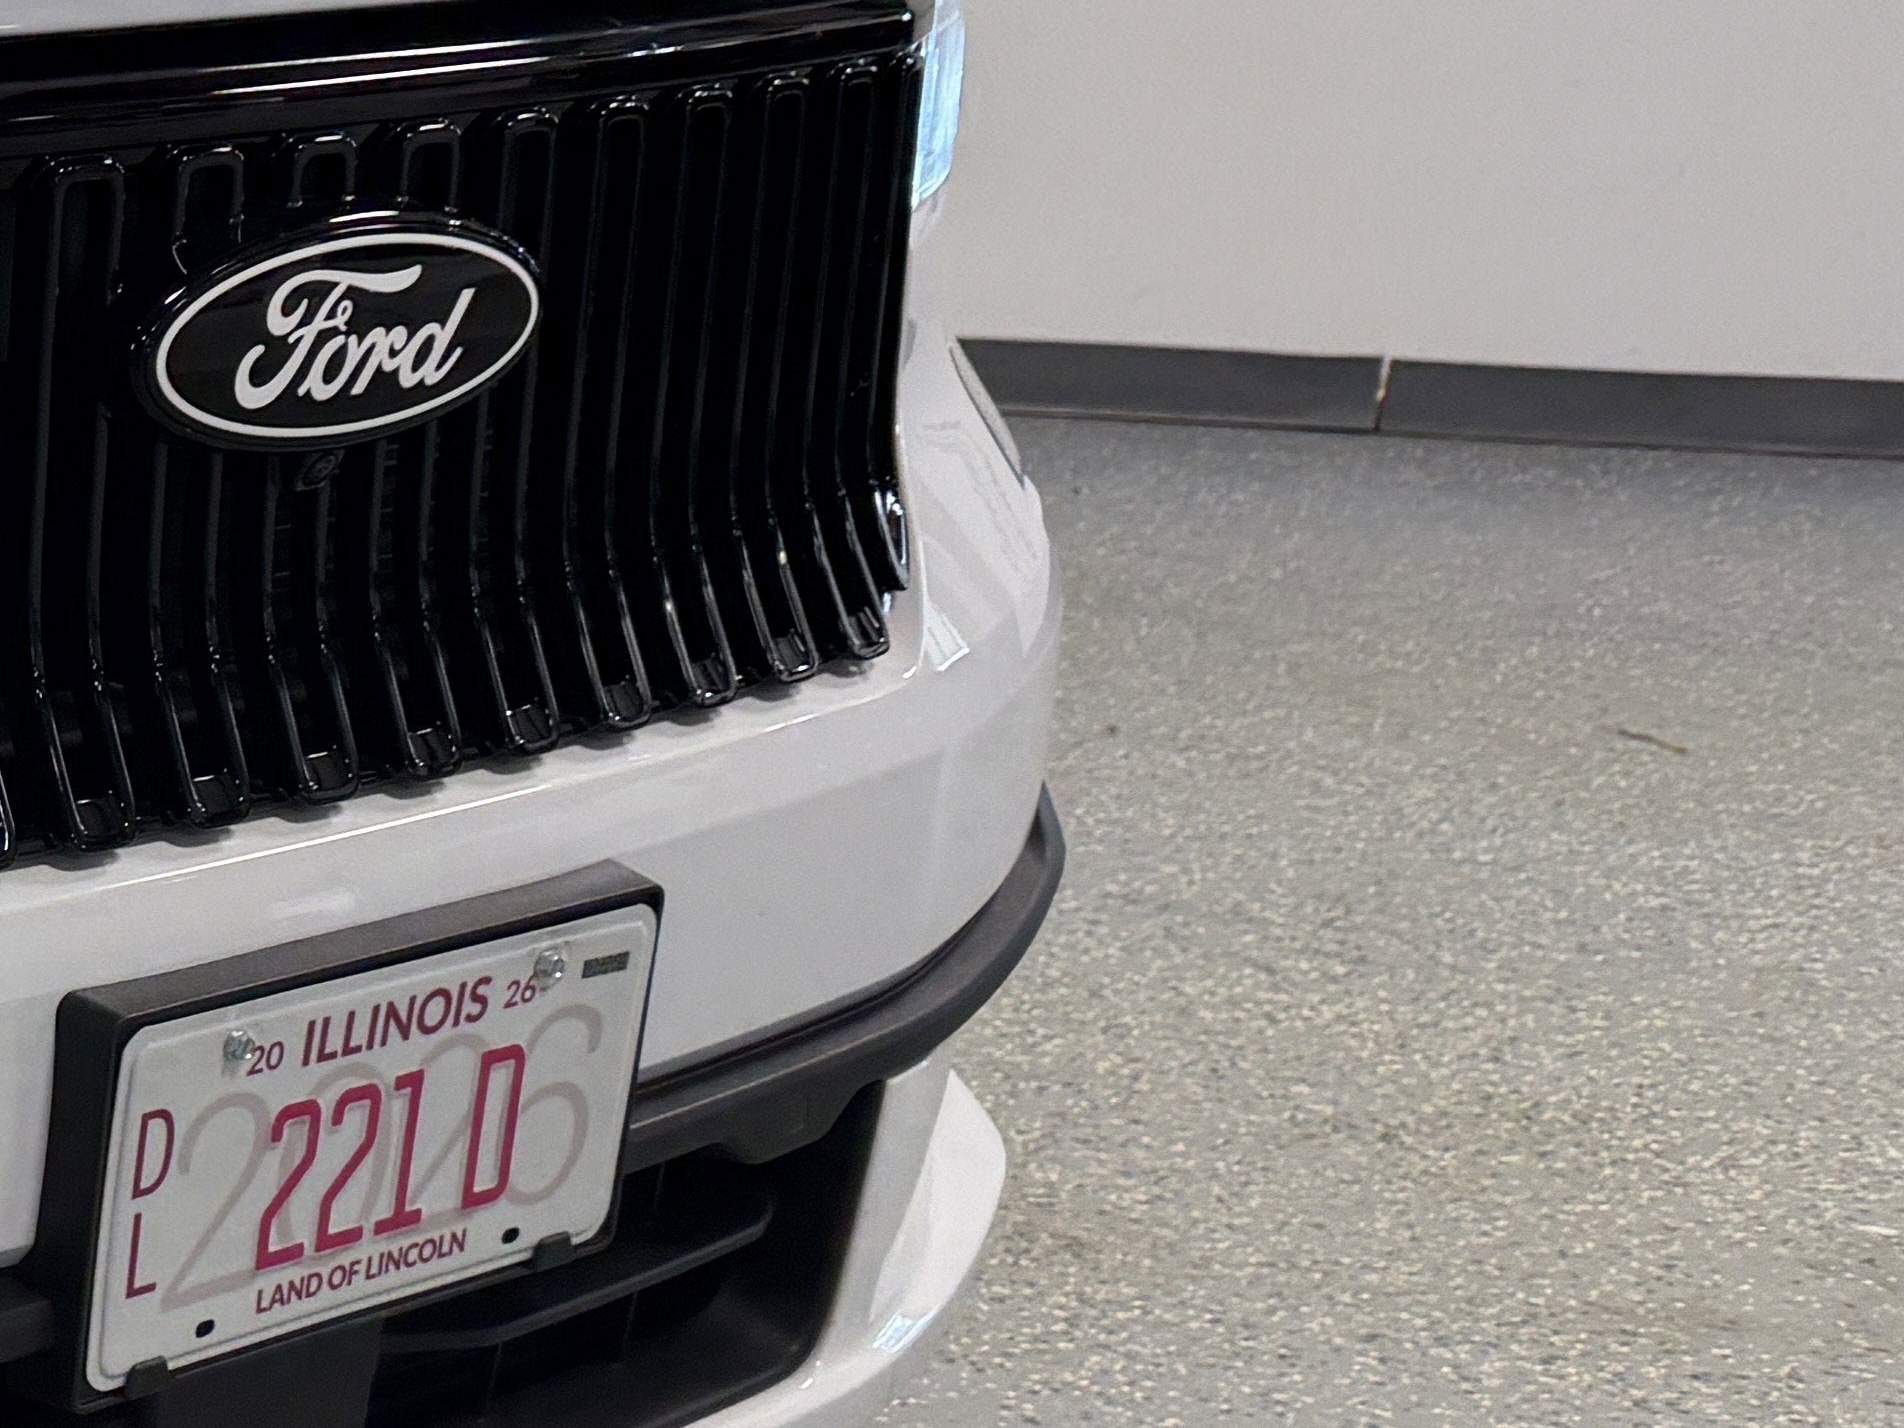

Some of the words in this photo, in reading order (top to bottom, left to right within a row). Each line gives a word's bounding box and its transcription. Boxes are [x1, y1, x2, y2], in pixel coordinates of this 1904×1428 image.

[234, 264, 477, 410] Ford
[246, 1040, 285, 1076] 20
[301, 975, 493, 1067] ILLINOIS
[503, 977, 537, 1009] 26
[254, 1068, 426, 1271] 221
[255, 1272, 323, 1315] LAND
[327, 1258, 363, 1291] OF
[364, 1227, 468, 1281] LINCOLN
